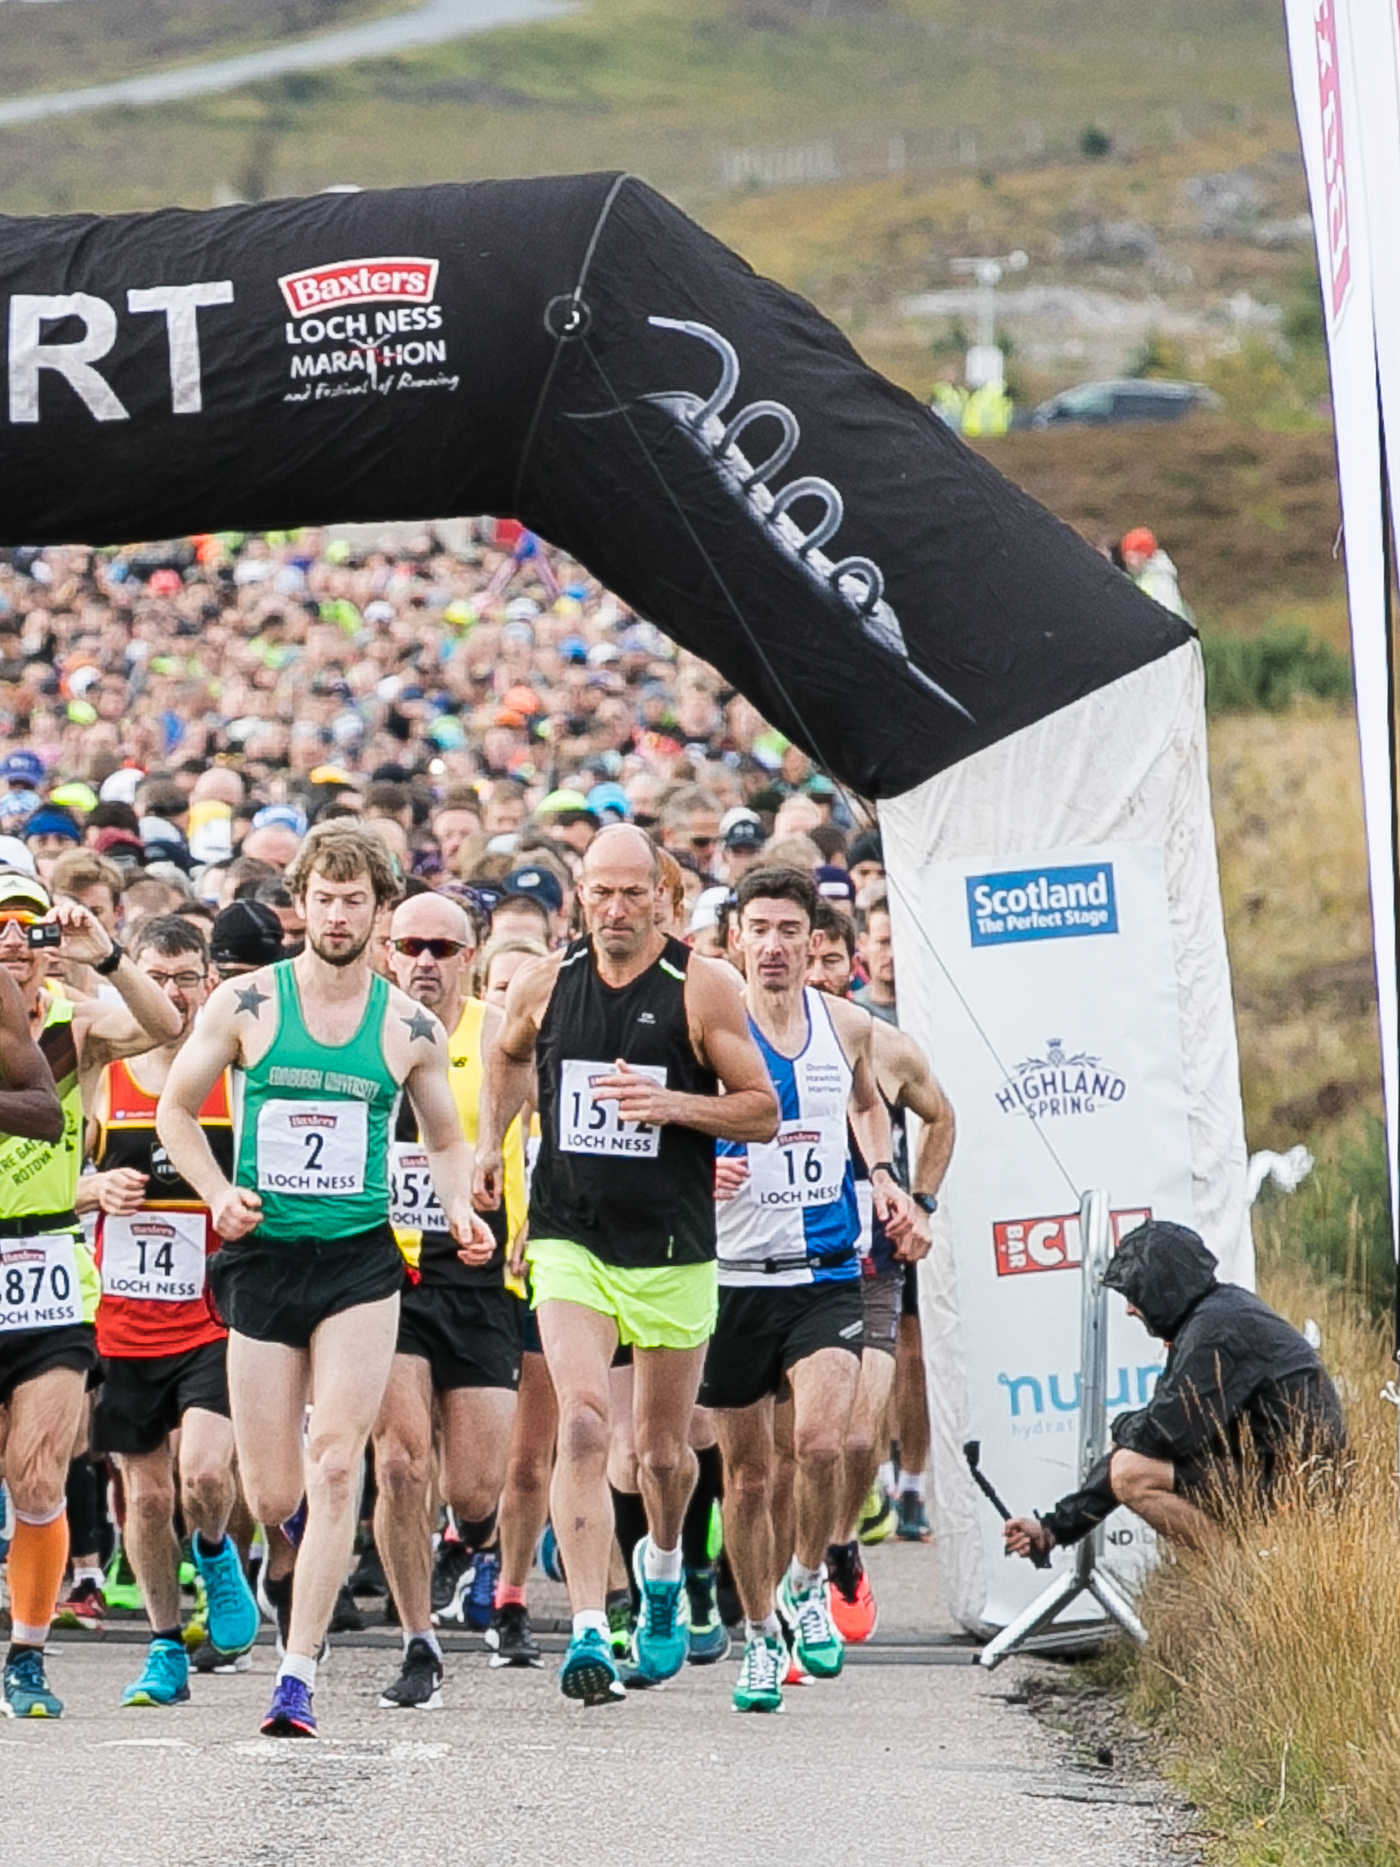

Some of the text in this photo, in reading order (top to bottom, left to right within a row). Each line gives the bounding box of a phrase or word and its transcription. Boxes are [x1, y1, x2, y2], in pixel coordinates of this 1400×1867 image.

[293, 268, 427, 307] Baxters
[286, 306, 443, 344] LOCH NESS
[974, 872, 1108, 918] Scotland
[978, 909, 1109, 934] The Perfect Stage
[994, 1070, 1126, 1114] HIGHLAND
[1028, 1096, 1096, 1119] SPRING
[304, 1132, 324, 1170] 2
[567, 1133, 652, 1152] LOCH NESS
[267, 1173, 356, 1189] LOCH NESS
[783, 1147, 822, 1186] 16
[760, 1189, 803, 1205] LOCH
[392, 1211, 447, 1227] OCH NE
[136, 1240, 174, 1277] 14
[1007, 1224, 1028, 1268] BAR
[110, 1278, 197, 1297] LOCH NESS
[34, 1305, 76, 1321] NESS
